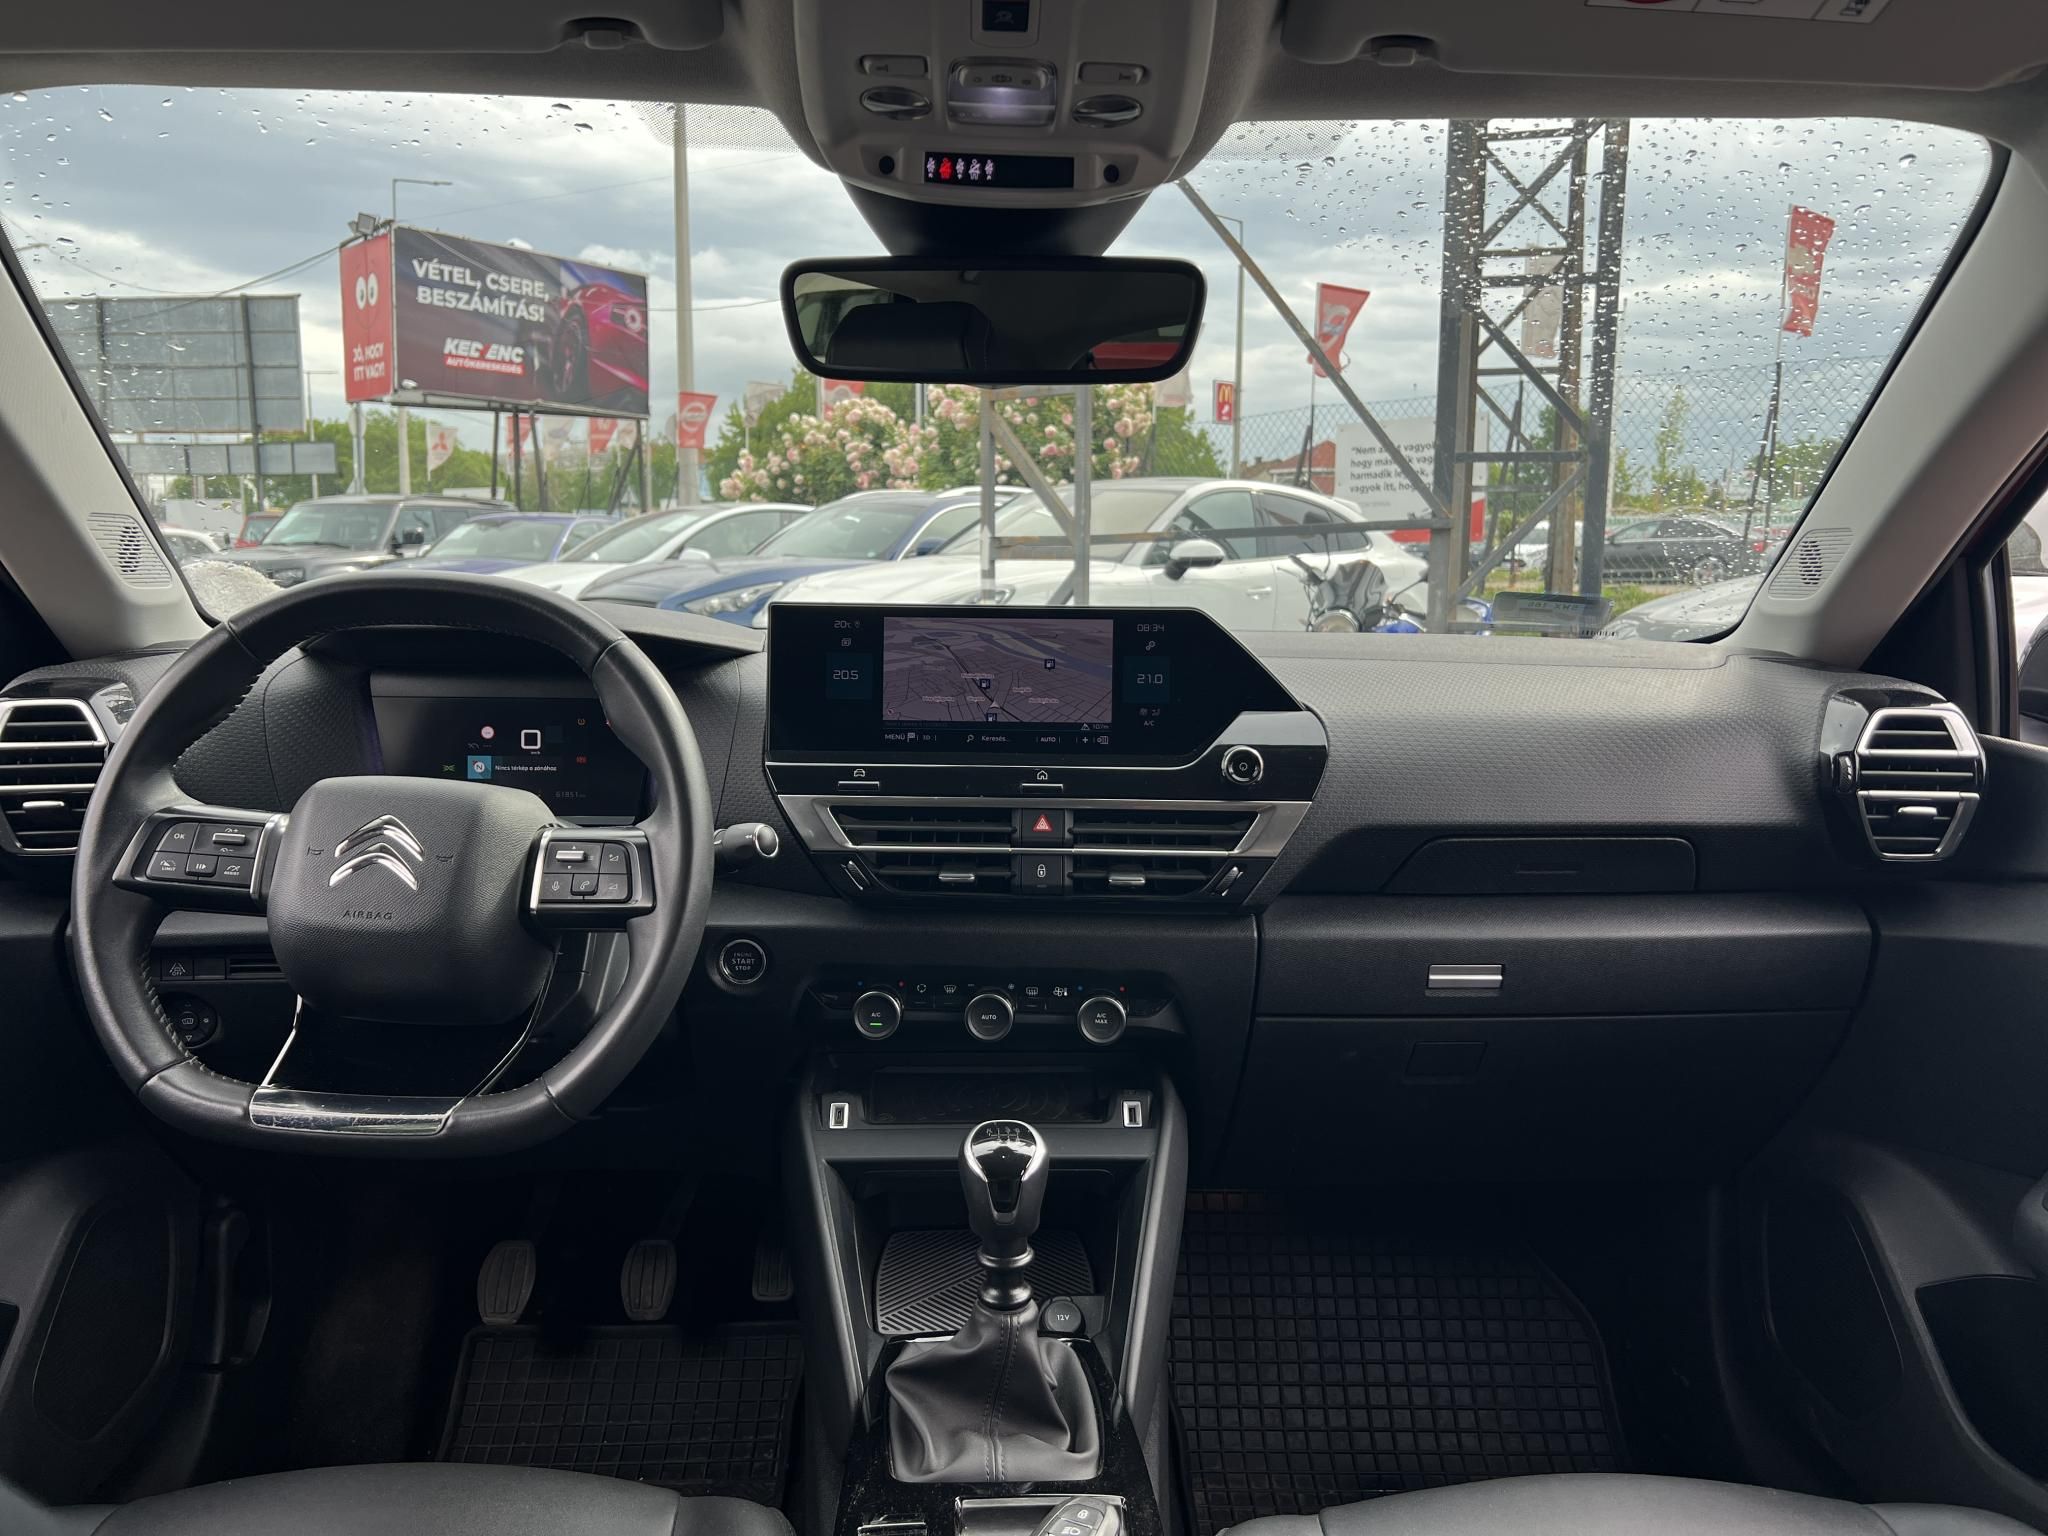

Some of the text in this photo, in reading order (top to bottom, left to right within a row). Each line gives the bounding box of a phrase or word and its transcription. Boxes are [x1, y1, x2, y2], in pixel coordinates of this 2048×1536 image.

[412, 258, 549, 302] VÉTEL, CSERE,
[416, 285, 545, 322] BESZÁMÍTÁS!
[1136, 623, 1165, 632] 08:34
[173, 832, 185, 840] OK
[342, 909, 393, 920] AIRBAG
